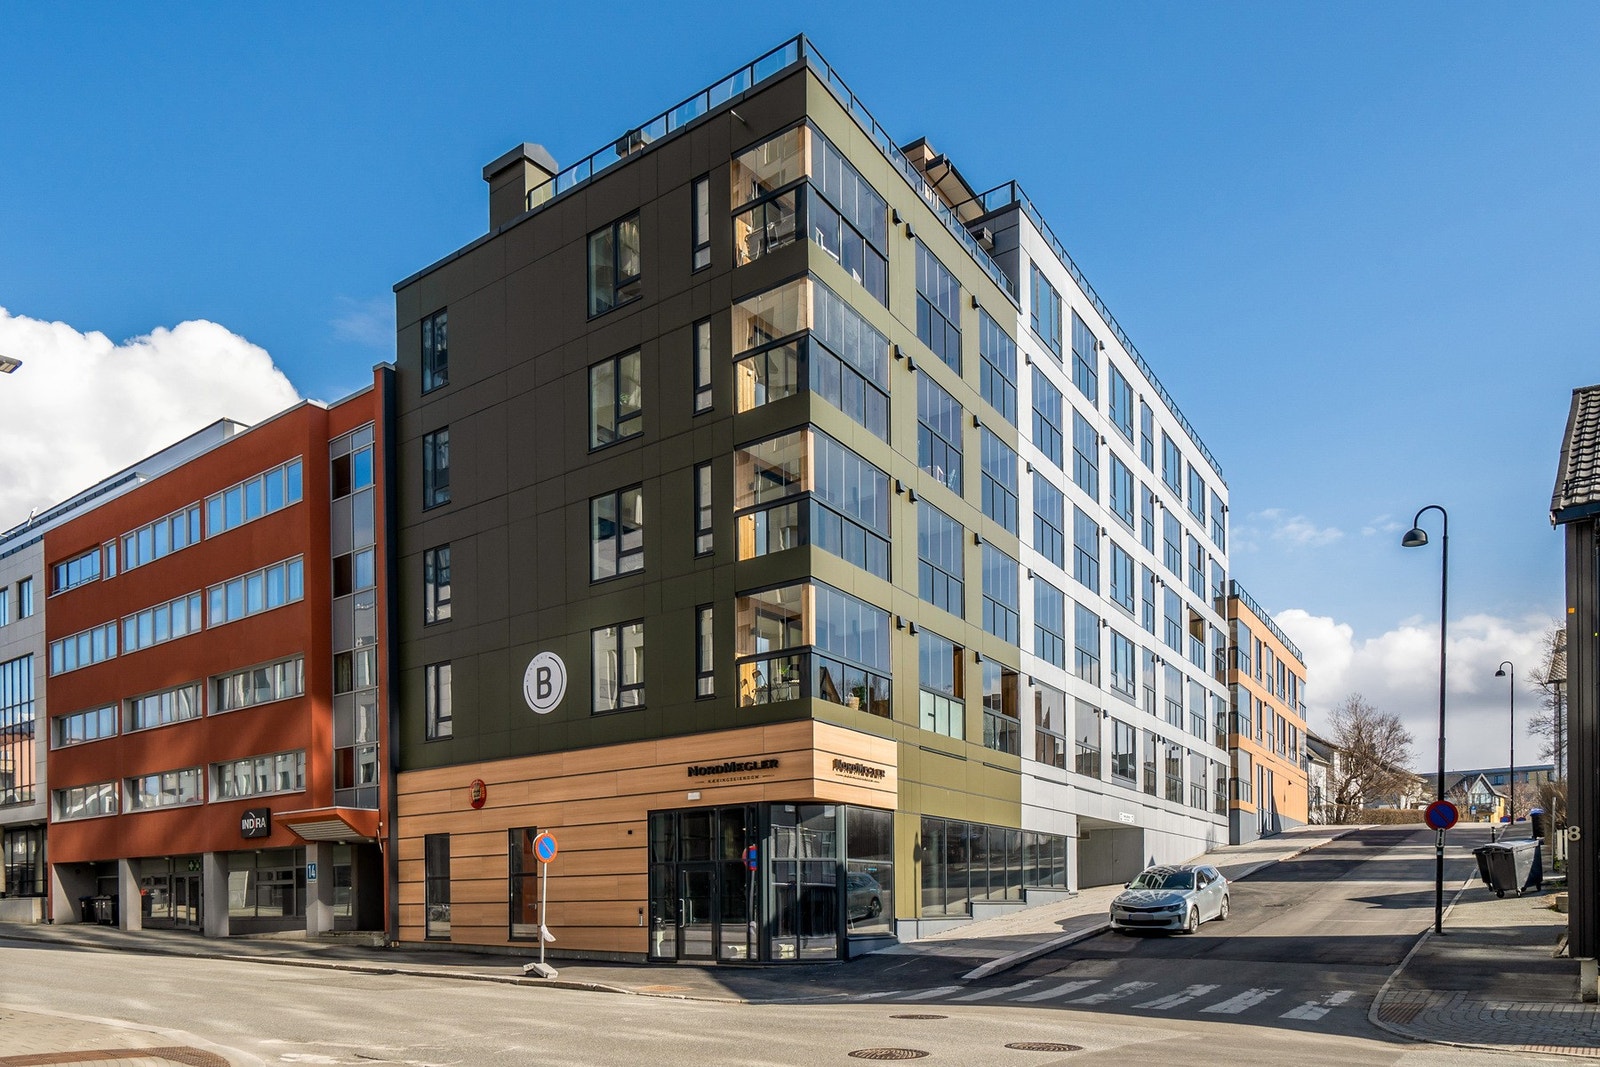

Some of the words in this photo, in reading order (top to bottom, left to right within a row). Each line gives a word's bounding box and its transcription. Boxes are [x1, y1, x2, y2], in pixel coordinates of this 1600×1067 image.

[537, 667, 552, 700] B
[1568, 825, 1581, 842] 8
[308, 865, 316, 879] 14
